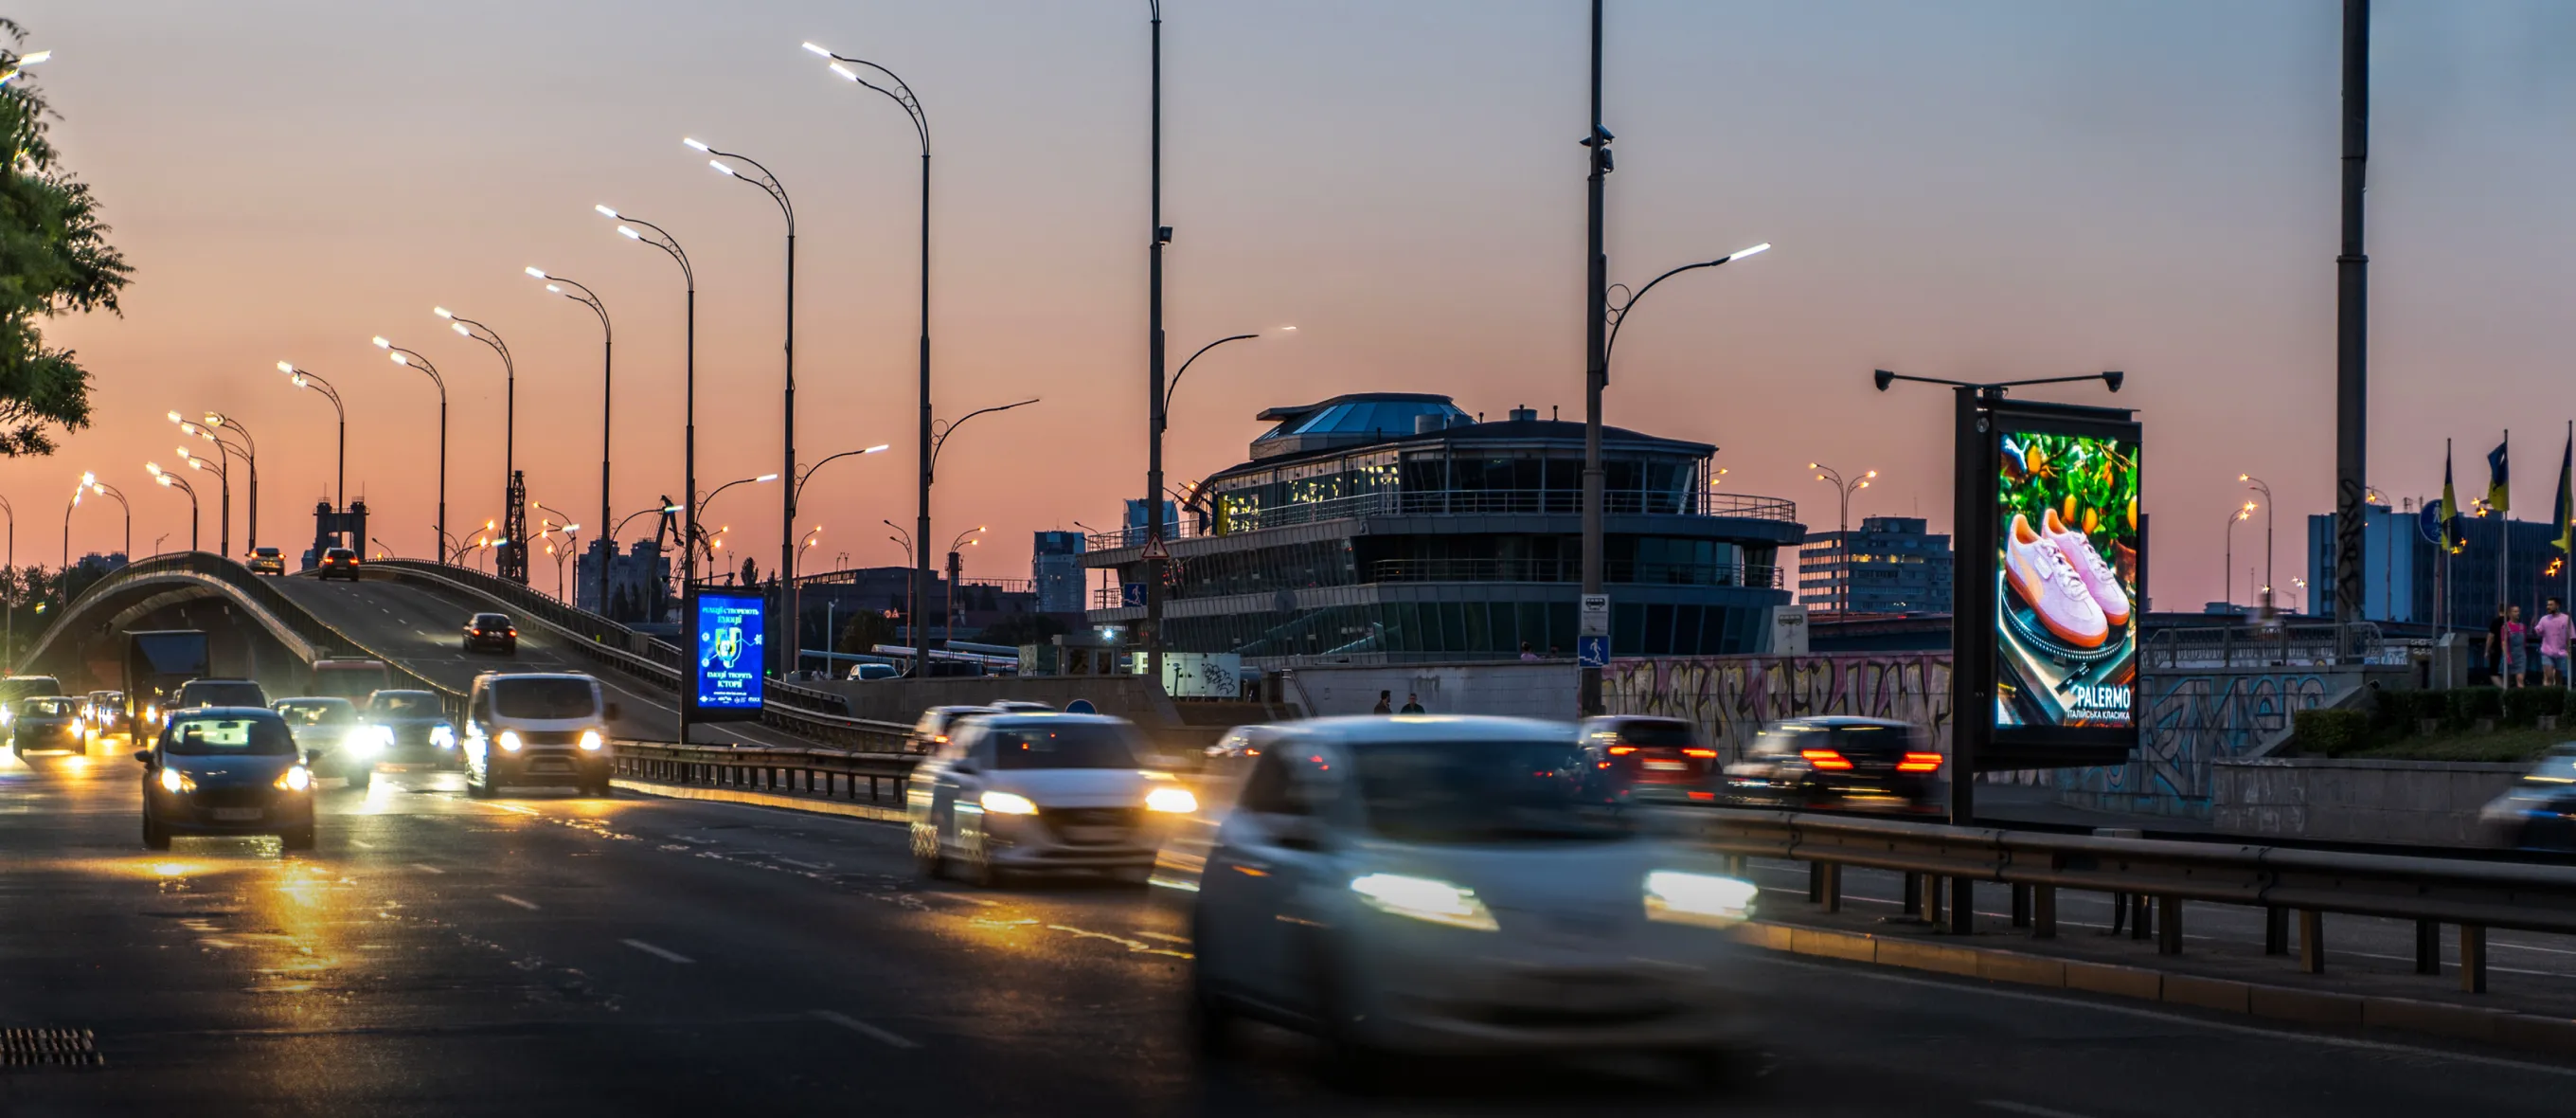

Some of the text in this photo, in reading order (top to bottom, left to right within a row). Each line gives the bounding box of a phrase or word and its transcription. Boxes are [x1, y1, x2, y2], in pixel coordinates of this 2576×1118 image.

[2077, 686, 2131, 709] PALERMO
[2067, 709, 2130, 719] ІТАЛІЙСЬКА КЛАСИКА
